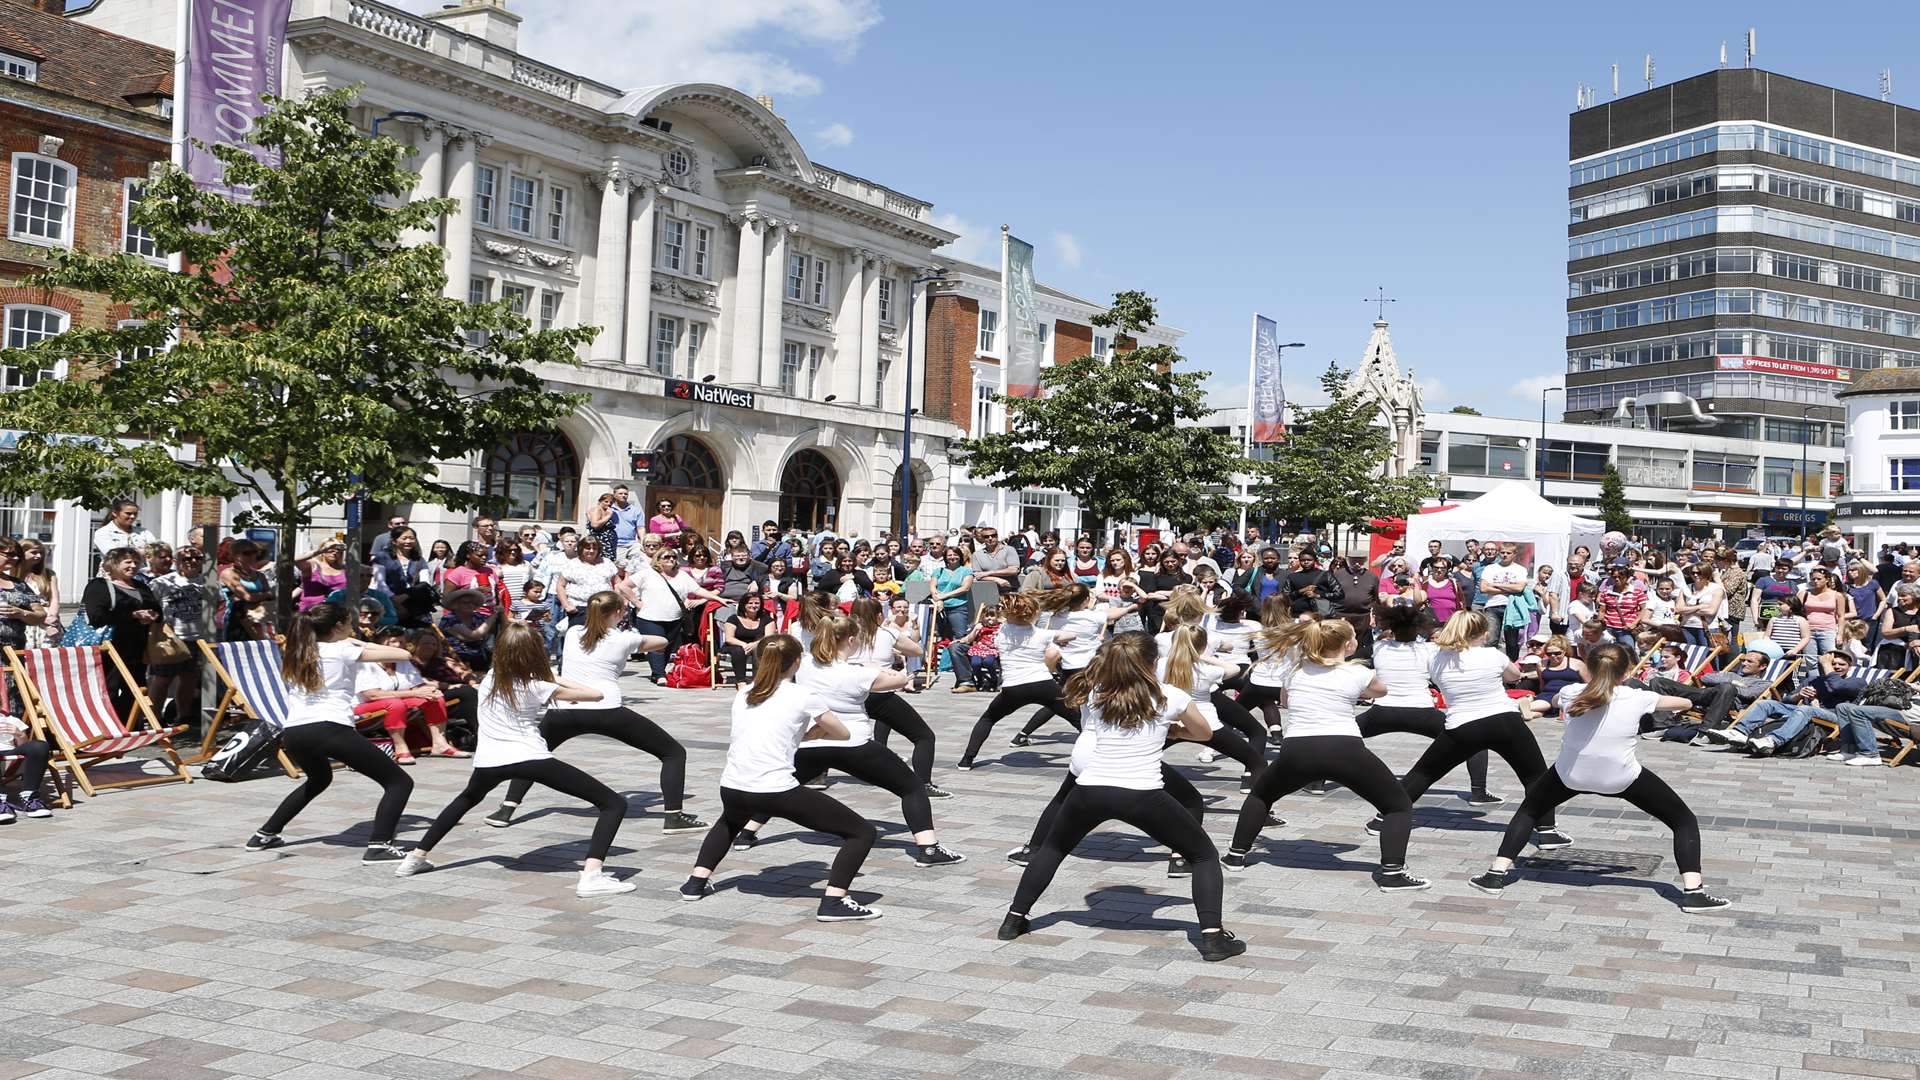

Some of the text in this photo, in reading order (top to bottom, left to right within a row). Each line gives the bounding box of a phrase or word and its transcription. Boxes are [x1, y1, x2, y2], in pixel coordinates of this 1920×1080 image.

[1010, 261, 1035, 366] WELCOME
[1259, 327, 1275, 413] BIENVENUE
[1746, 359, 1771, 368] OFFICES
[1790, 364, 1806, 372] FROM
[694, 384, 752, 408] NatWest
[1837, 507, 1851, 516] LUSH
